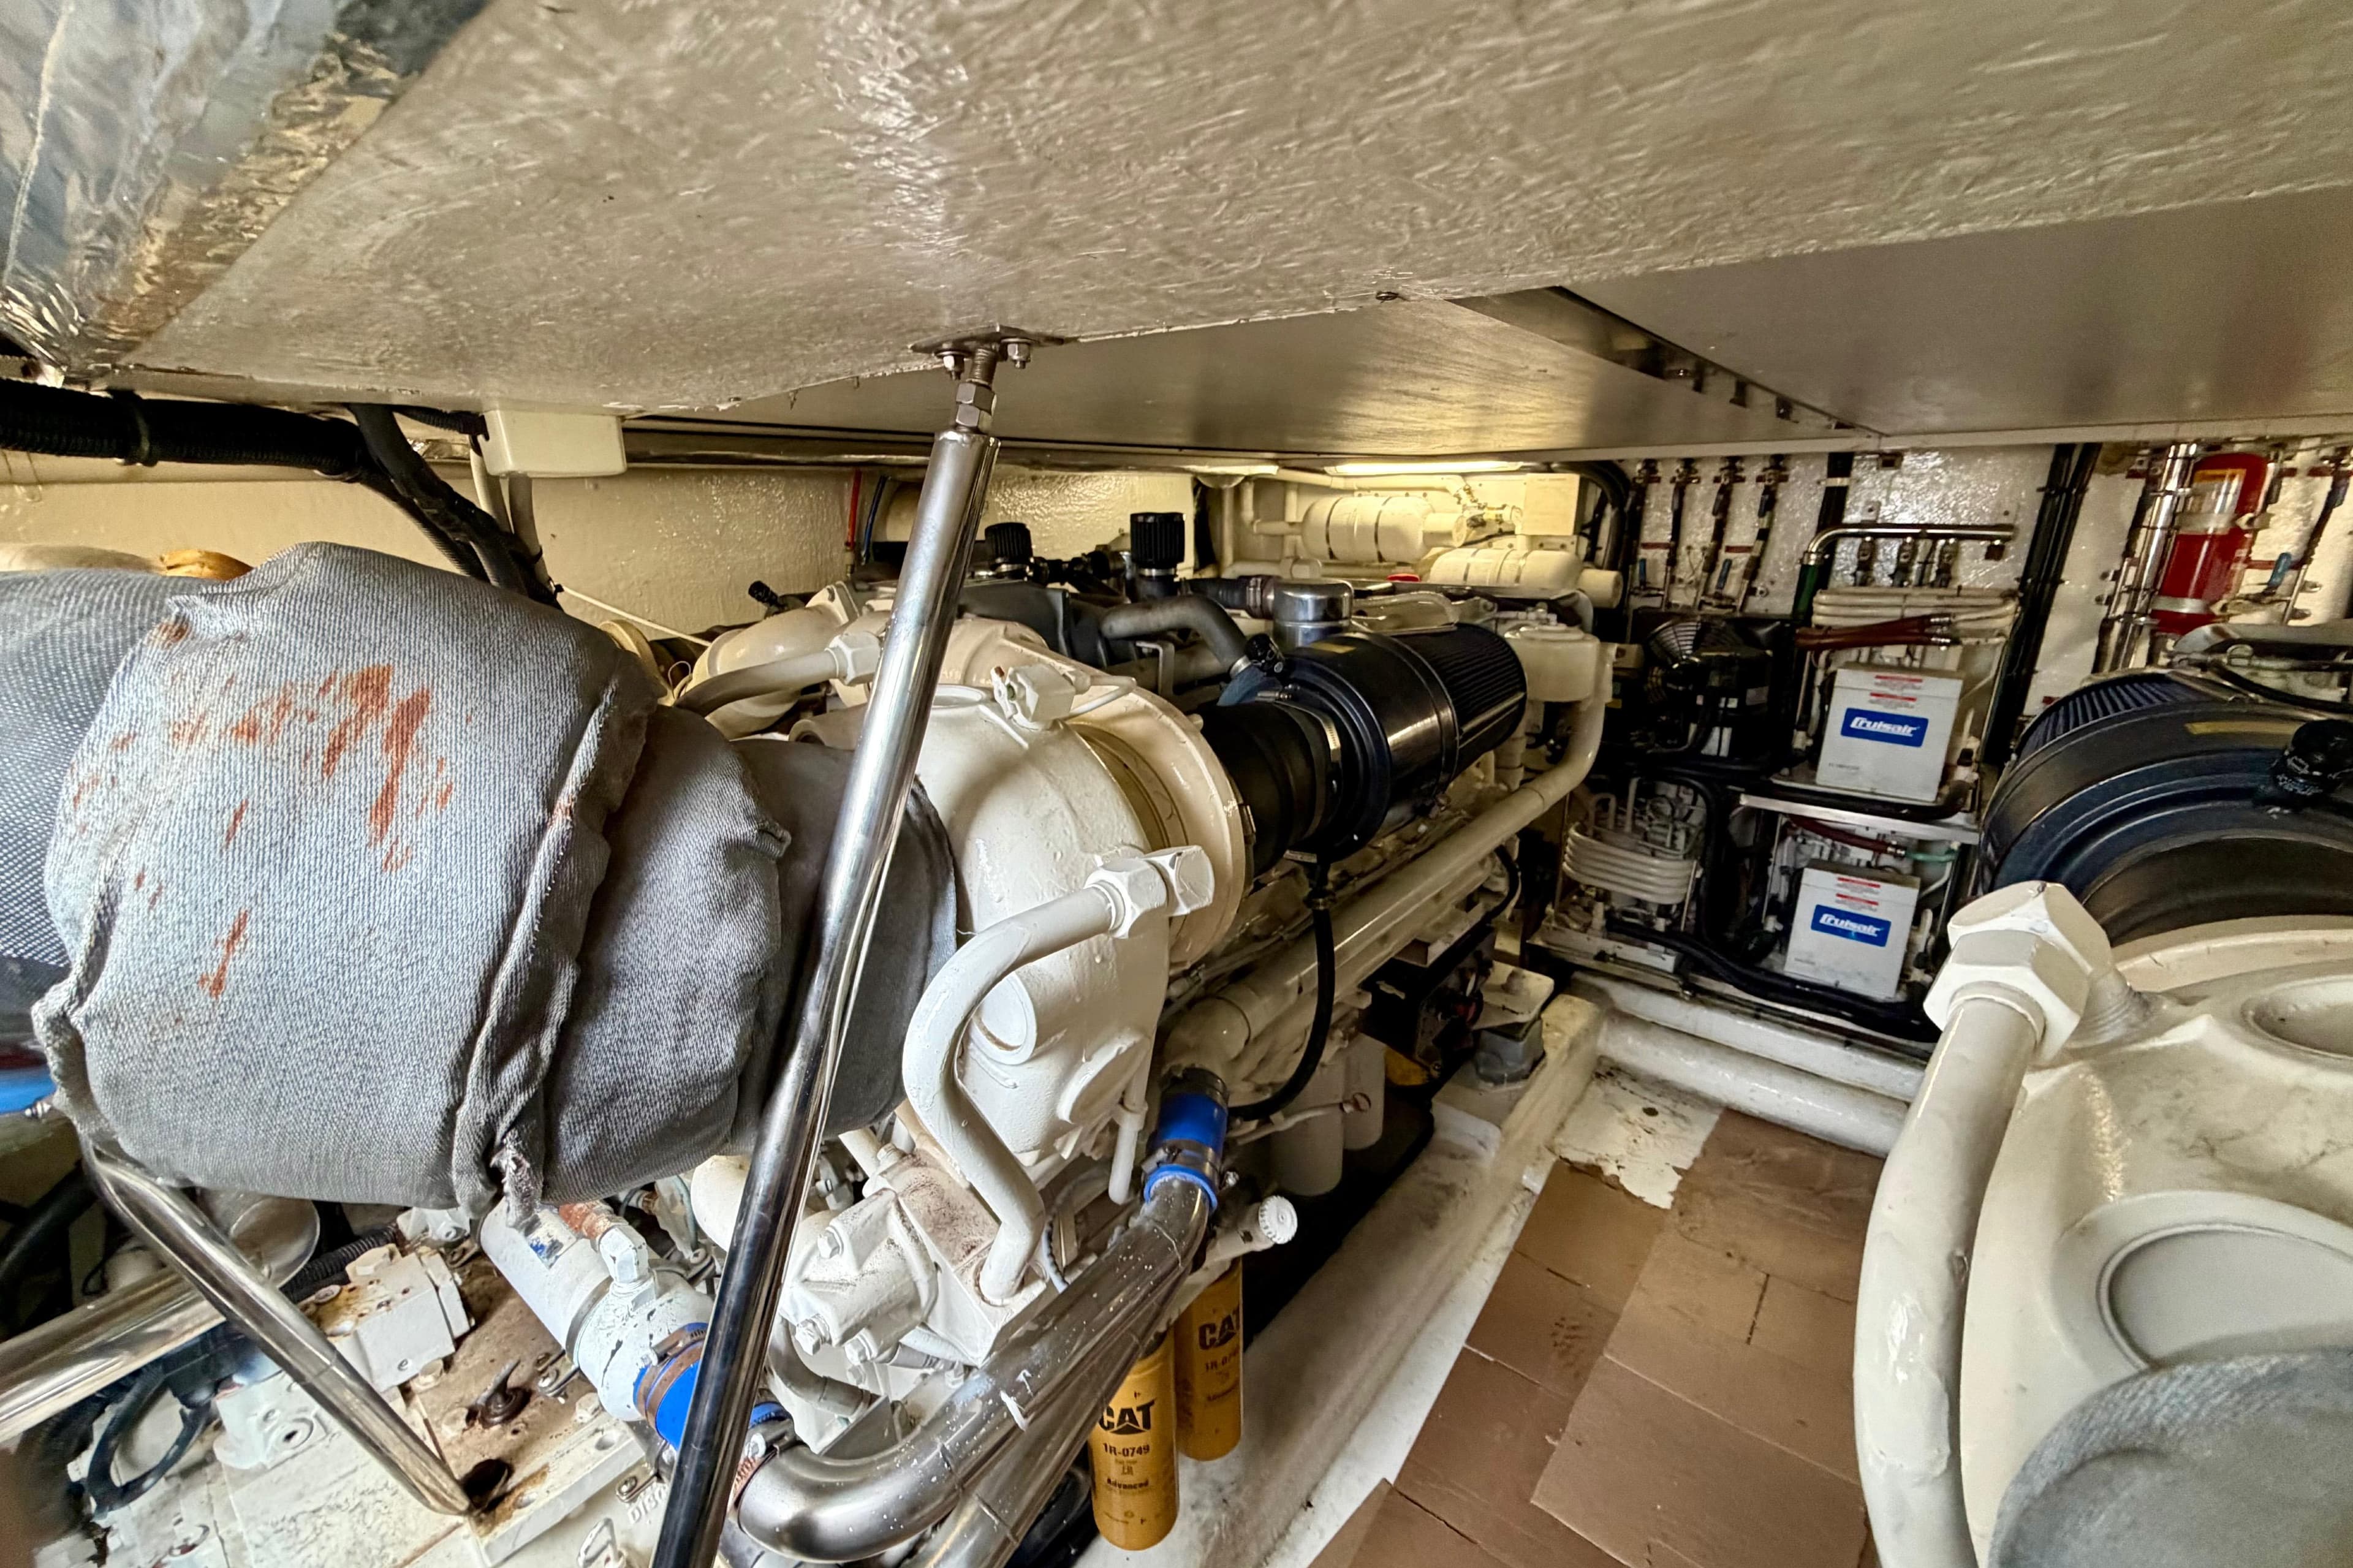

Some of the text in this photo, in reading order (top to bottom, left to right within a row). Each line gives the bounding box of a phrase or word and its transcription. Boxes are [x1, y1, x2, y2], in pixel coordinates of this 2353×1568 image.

[1850, 716, 1917, 737] Cruisair
[1819, 913, 1881, 937] Cruisair
[1098, 1398, 1157, 1435] CAT
[1103, 1442, 1150, 1458] 1R-0749
